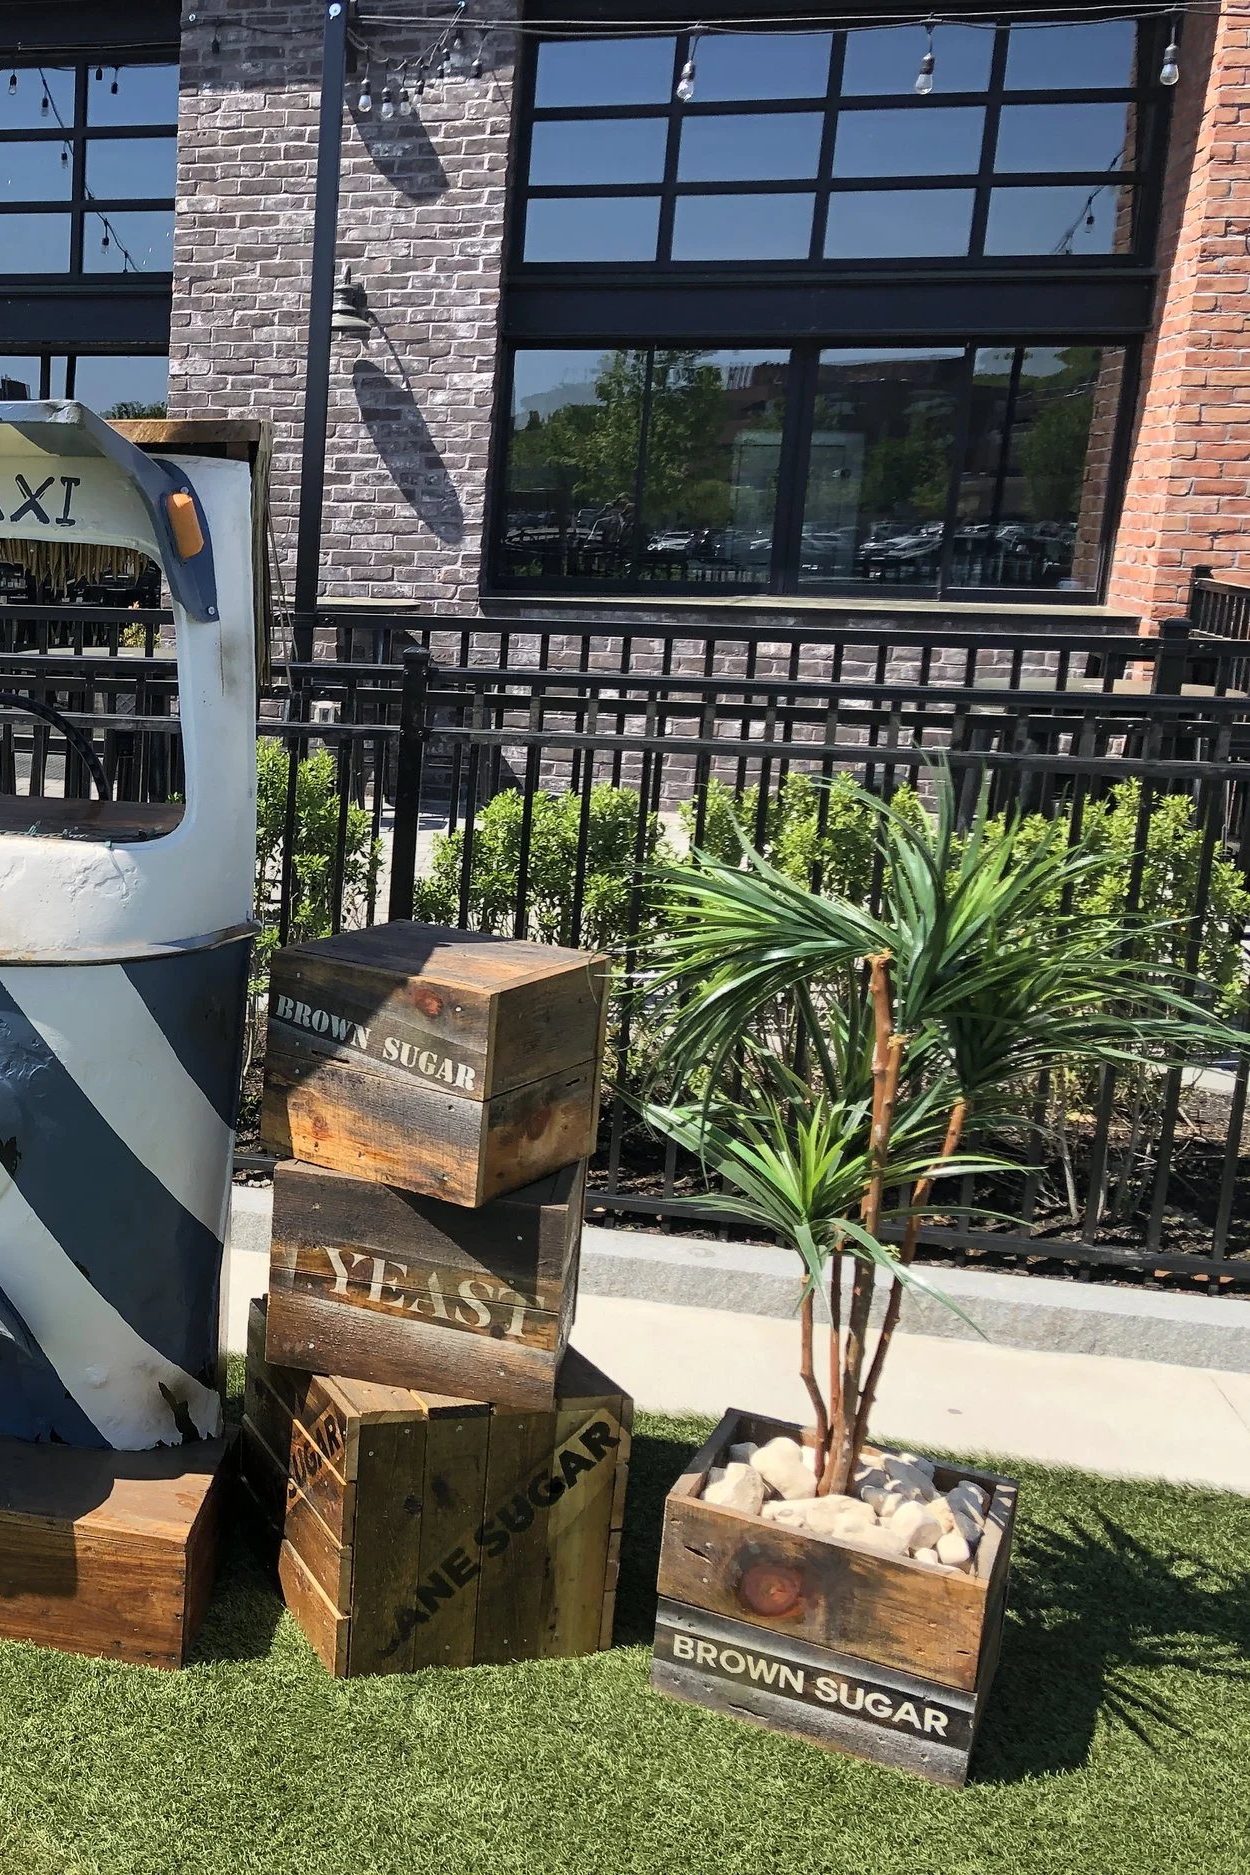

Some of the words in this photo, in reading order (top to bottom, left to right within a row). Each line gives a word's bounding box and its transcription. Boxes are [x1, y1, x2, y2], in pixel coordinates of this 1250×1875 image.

[275, 994, 372, 1051] BROWN
[382, 1037, 476, 1091] SUGAR
[322, 1245, 545, 1338] YEAST
[475, 1420, 621, 1559] SUGAR
[672, 1633, 804, 1694] BROWN
[814, 1676, 949, 1737] SUGAR
